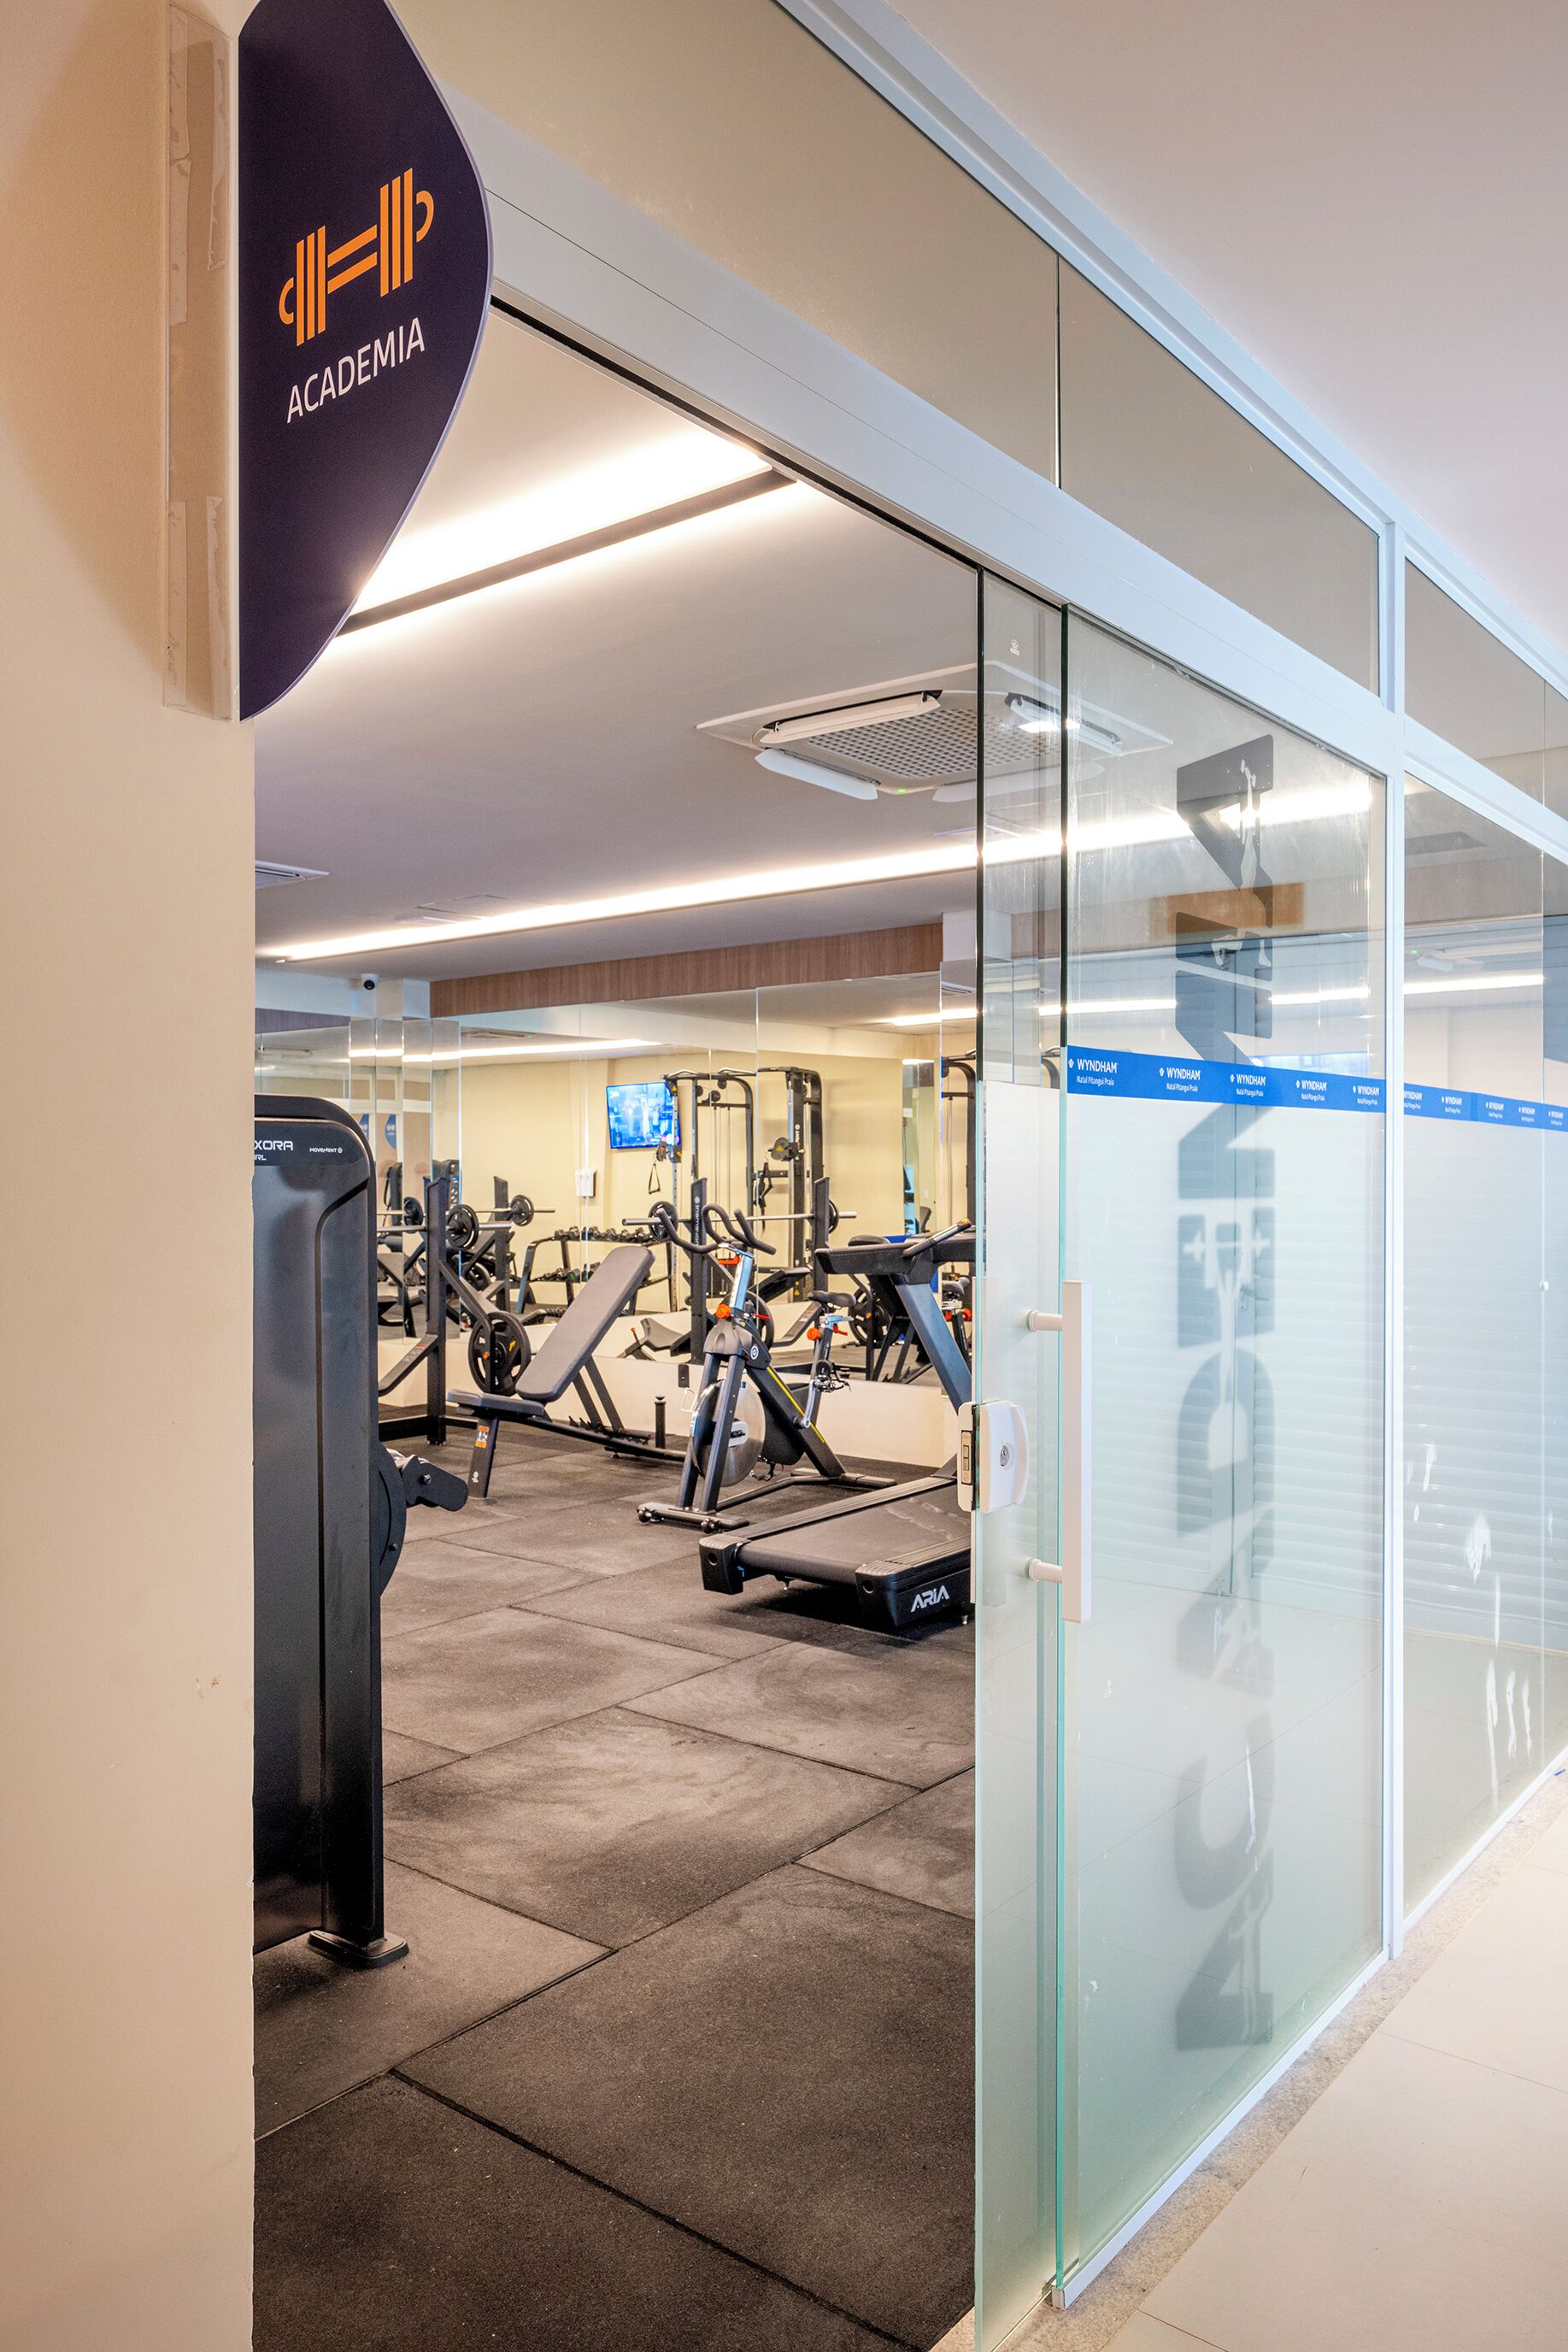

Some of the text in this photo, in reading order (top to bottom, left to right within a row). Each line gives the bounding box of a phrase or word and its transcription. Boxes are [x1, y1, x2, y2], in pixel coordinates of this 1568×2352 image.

[287, 317, 426, 424] ACADEMIA
[1077, 1059, 1118, 1073] WYNDHAM
[1166, 1067, 1201, 1080] WYNDHAM
[1236, 1074, 1266, 1085] WYNDHAM
[1077, 1075, 1088, 1084] Natal
[1104, 1078, 1114, 1086] Praia
[1301, 1080, 1327, 1091] WYNDHAM
[255, 1140, 294, 1151] XORA
[911, 1585, 949, 1613] ARIA
